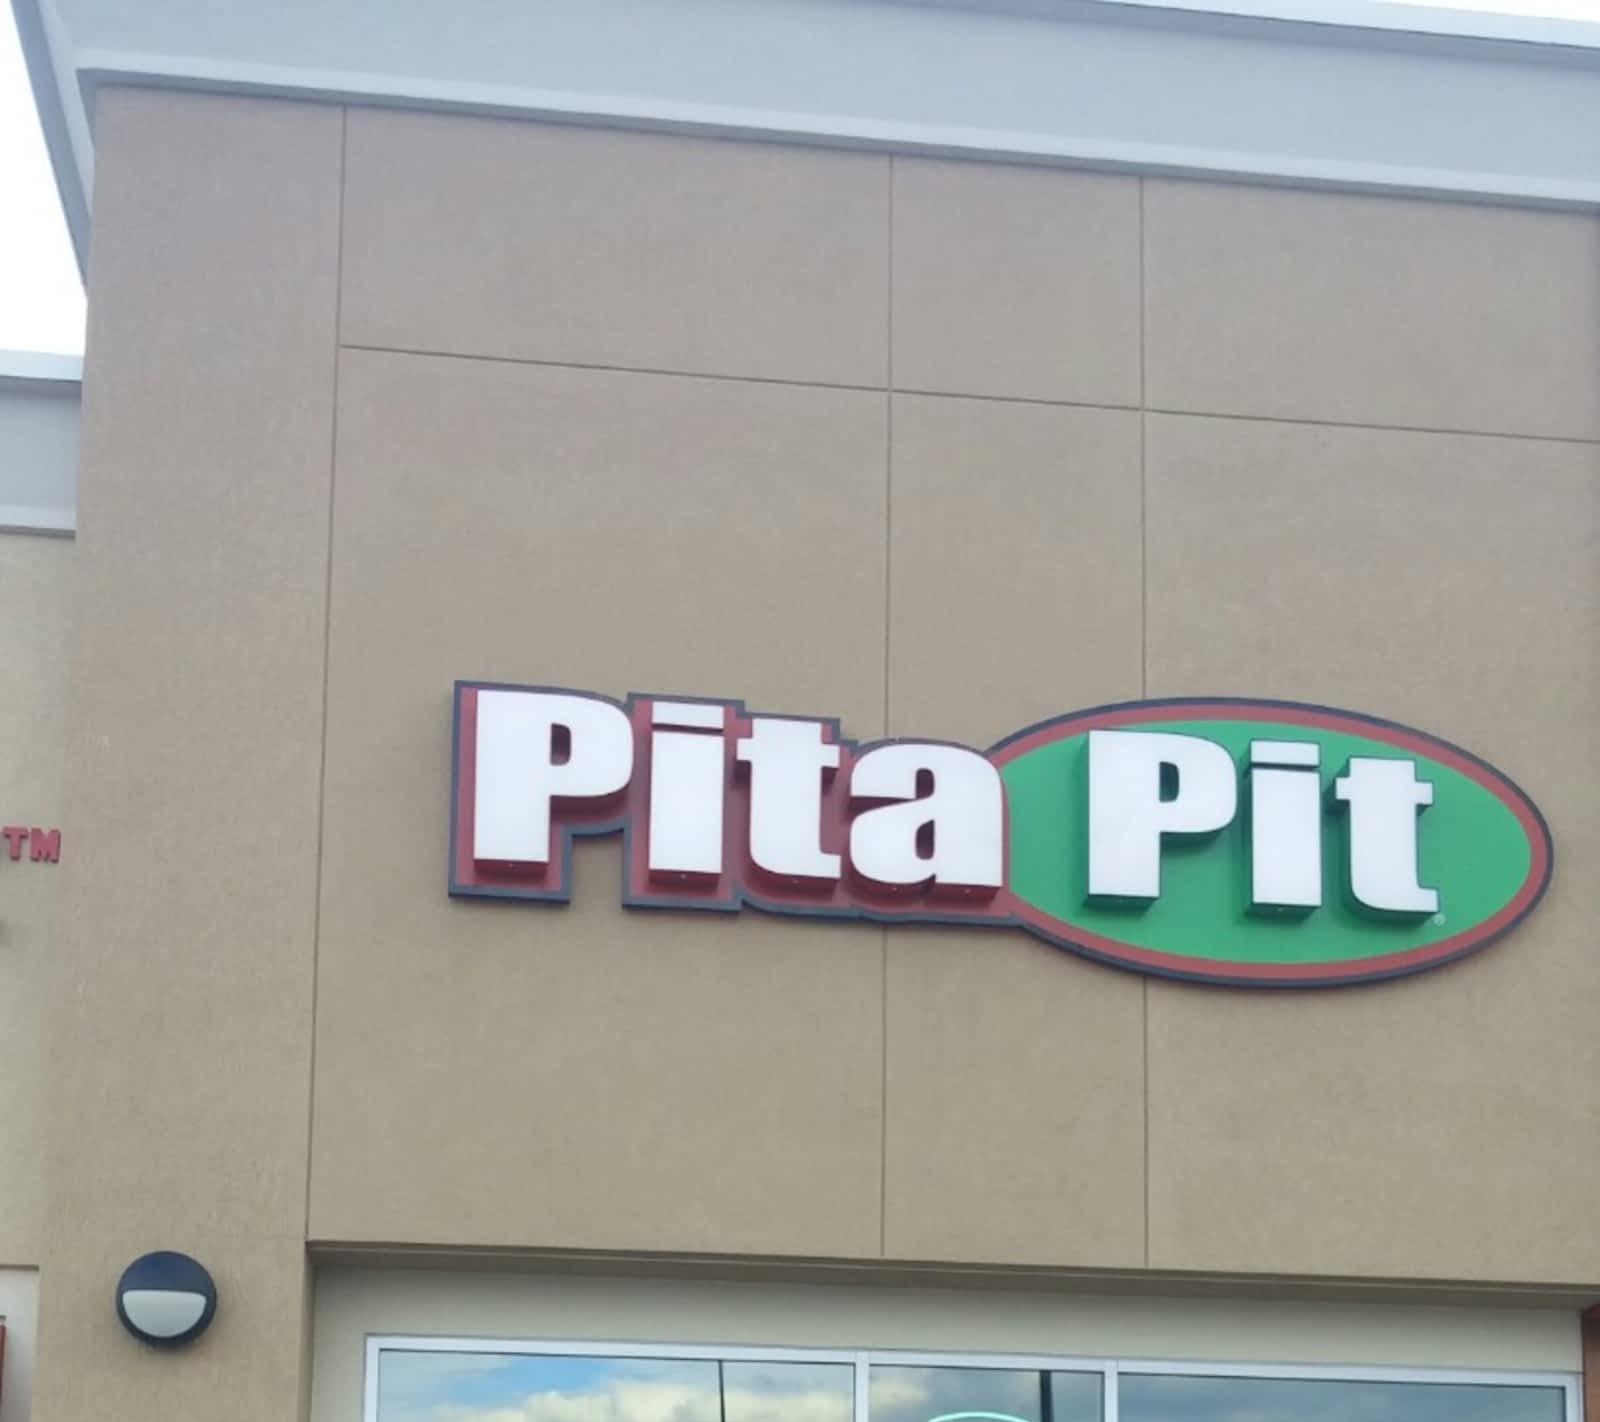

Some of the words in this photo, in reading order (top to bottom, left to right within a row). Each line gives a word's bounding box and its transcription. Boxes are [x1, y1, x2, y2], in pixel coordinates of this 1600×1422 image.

[3, 826, 62, 864] TM
[472, 689, 1004, 896] Pita
[1085, 729, 1440, 917] Pit
